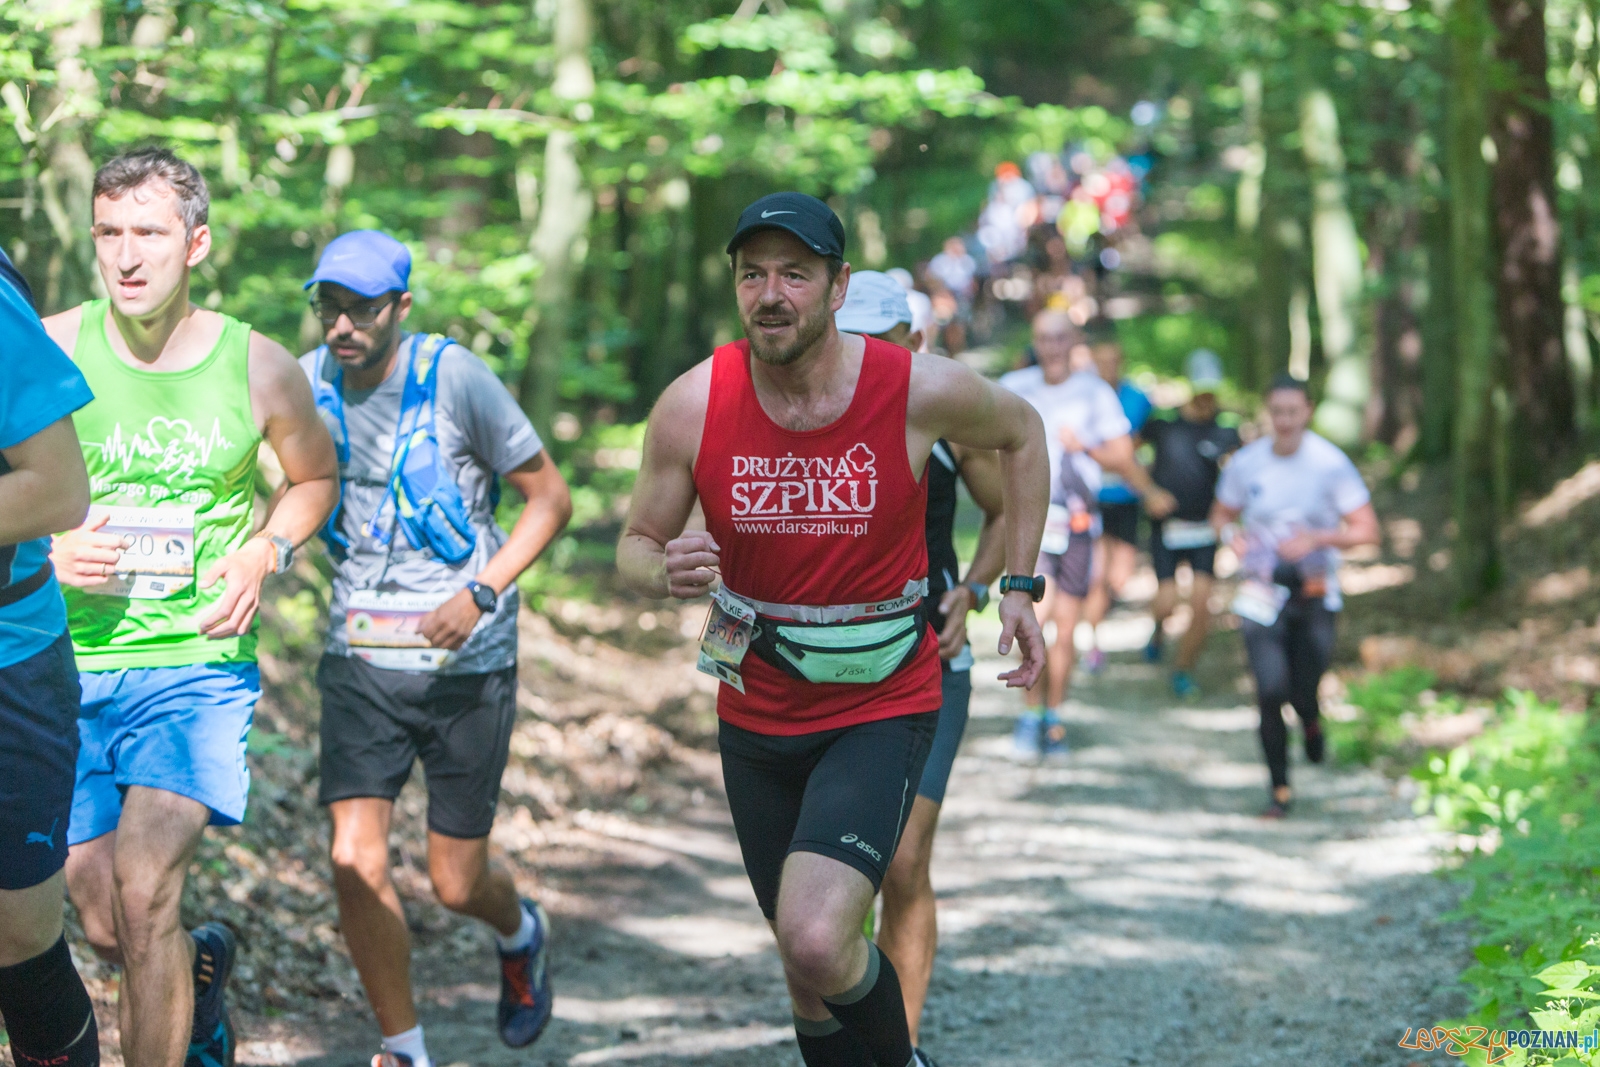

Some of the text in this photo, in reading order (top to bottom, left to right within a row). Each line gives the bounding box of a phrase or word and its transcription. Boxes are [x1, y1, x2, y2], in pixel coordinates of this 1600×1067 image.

[732, 452, 852, 477] DRUŻYNA
[90, 476, 146, 497] Marago
[172, 489, 212, 504] Team
[731, 479, 878, 515] SZPIKU
[734, 520, 868, 538] www.darszpiku.pl
[114, 532, 154, 556] 20
[856, 840, 883, 862] asics
